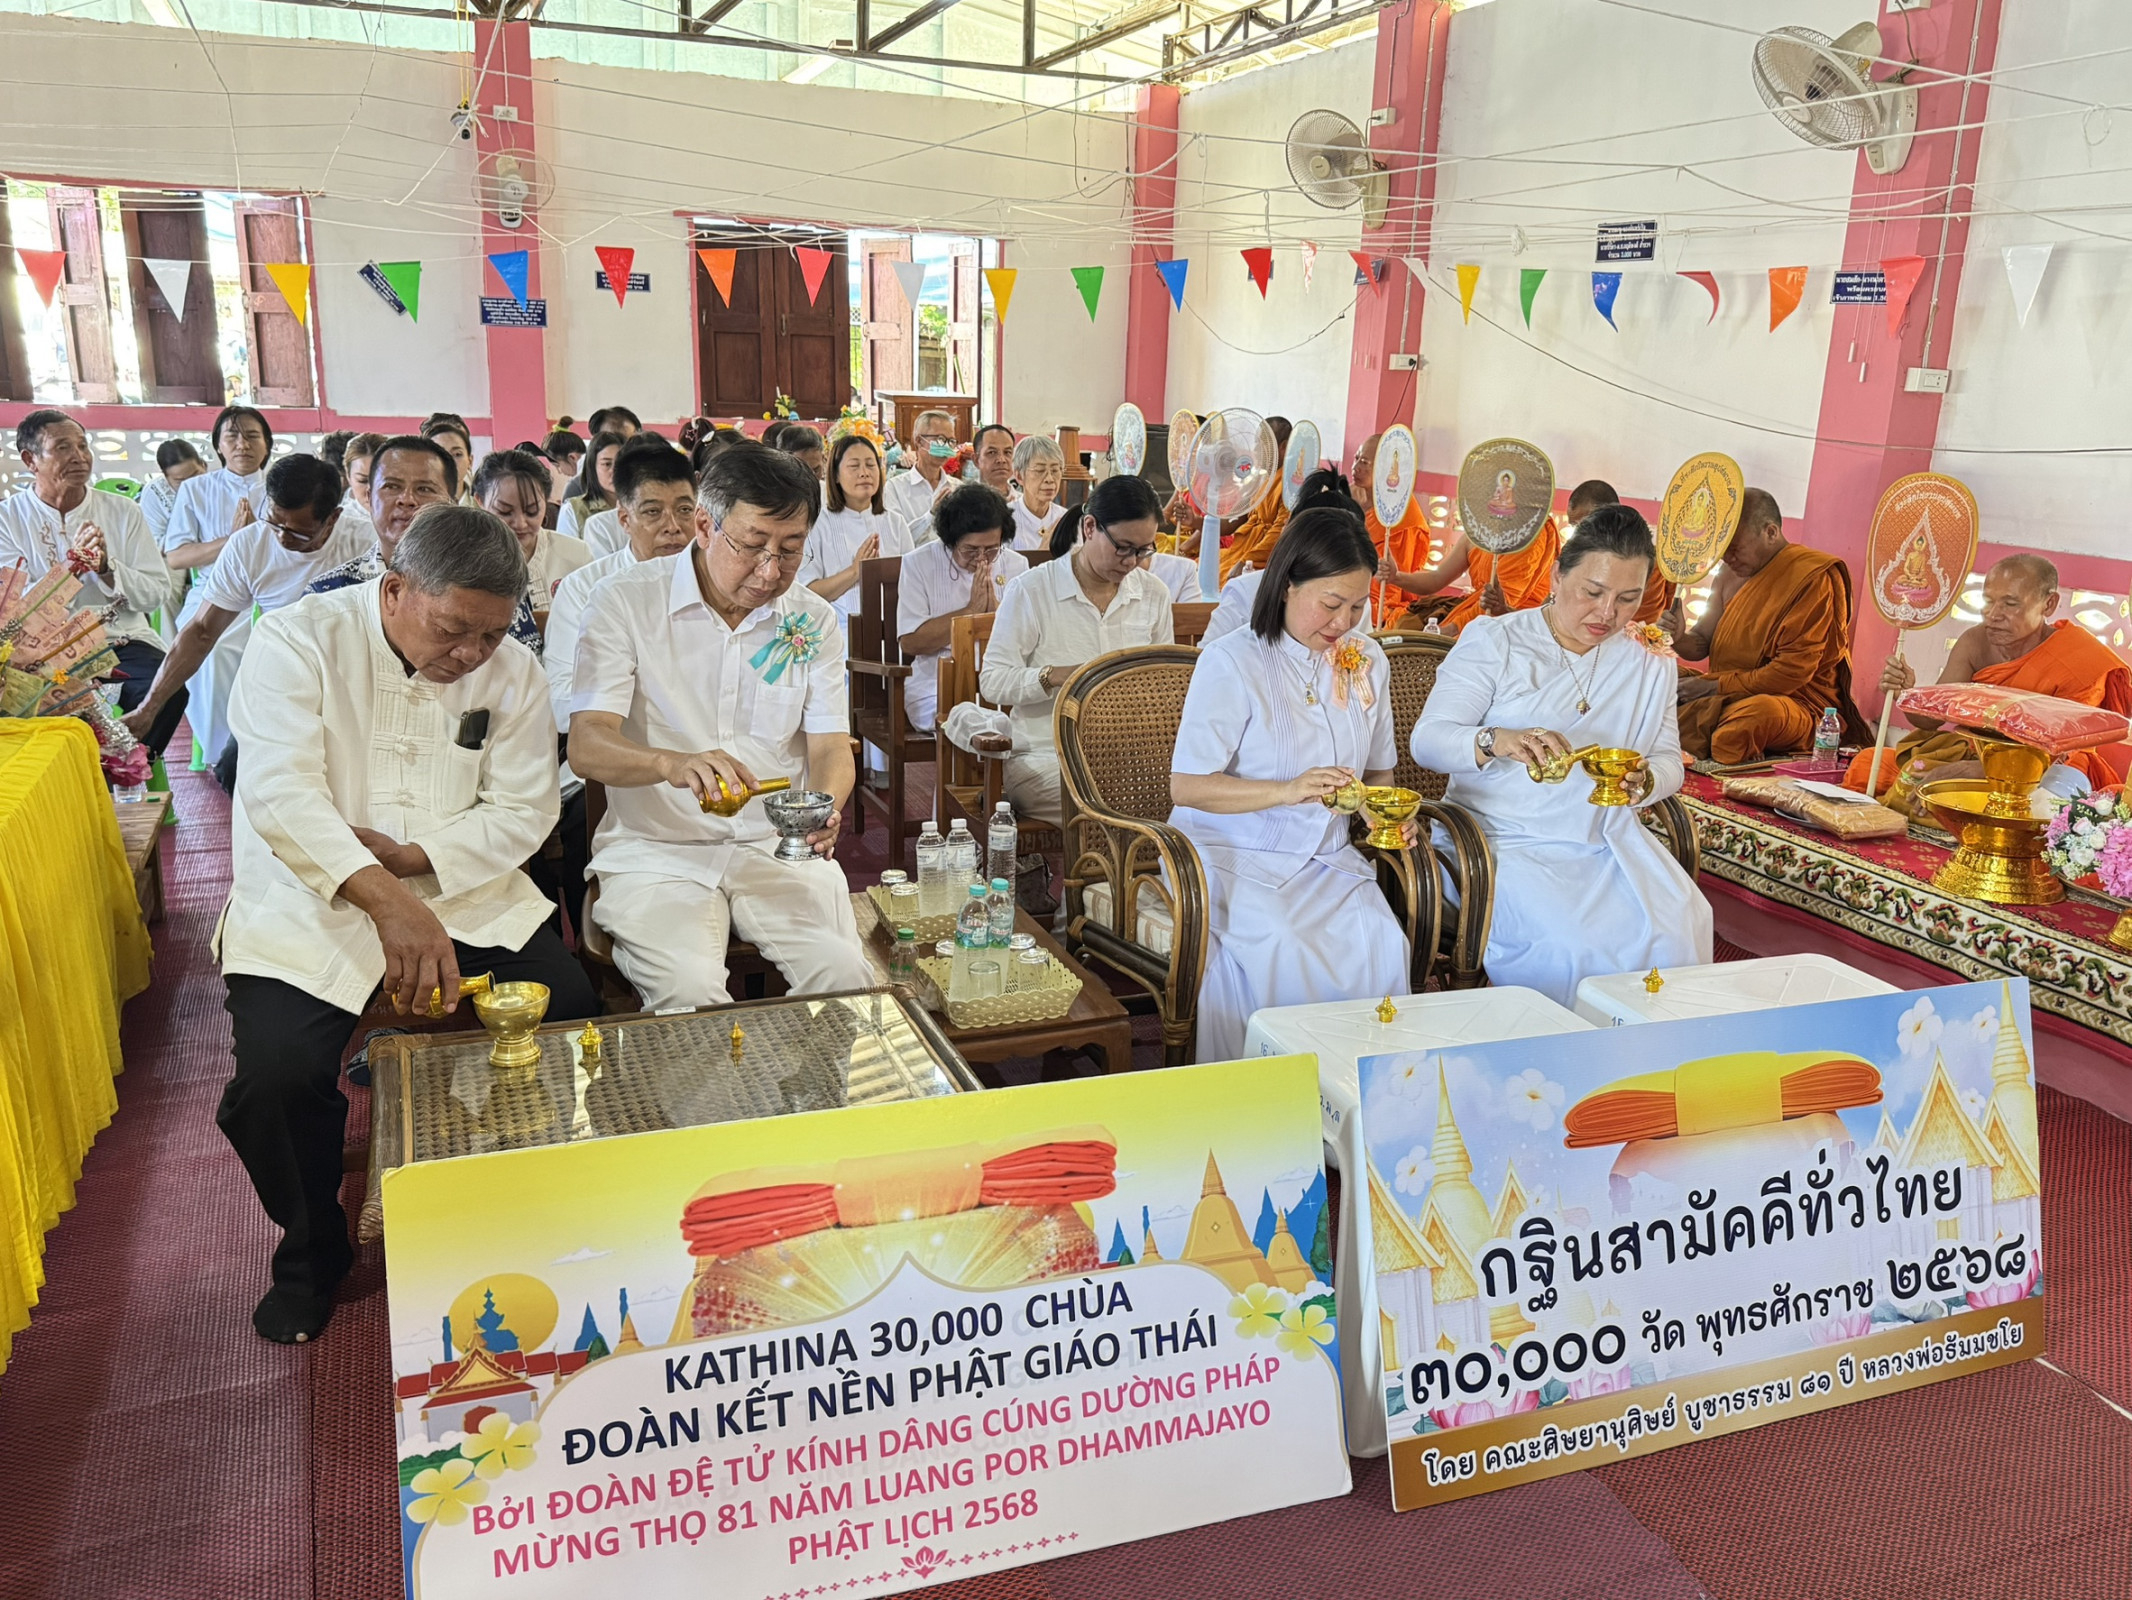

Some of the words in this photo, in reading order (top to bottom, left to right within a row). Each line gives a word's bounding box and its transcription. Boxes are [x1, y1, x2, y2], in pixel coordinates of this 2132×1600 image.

[1480, 1148, 1962, 1313] กฐินสามัคคีทั่วไทย
[562, 1405, 701, 1465] ĐOÀN
[717, 1380, 794, 1438] KẾT
[808, 1366, 895, 1422] NỀN
[910, 1348, 1011, 1403] PHẬT
[1023, 1328, 1121, 1381] GIÁO
[1130, 1309, 1218, 1358] THÁI
[665, 1327, 857, 1394] KATHINA
[870, 1302, 1002, 1357] 30,000
[1025, 1277, 1133, 1329] CHÙA
[1410, 1324, 1627, 1405] ๓๐,๐๐๐
[1641, 1308, 1686, 1354] วัด
[1696, 1278, 1874, 1357] พุทธศักราช
[1886, 1233, 2027, 1301] ๒๕๖๘
[546, 1473, 656, 1520] ĐOÀN
[667, 1455, 715, 1498] ĐỆ
[723, 1442, 775, 1482] TỬ
[787, 1432, 868, 1477] KÍNH
[879, 1416, 972, 1459] DÂNG
[982, 1397, 1072, 1435] CÚNG
[1081, 1374, 1197, 1419] DƯỜNG
[1205, 1353, 1282, 1394] PHÁP
[1425, 1453, 1475, 1482] โดย
[1485, 1396, 1676, 1471] คณะศิษยานุศิษย์
[1684, 1380, 1792, 1430] บูชาธรรม
[1800, 1371, 1831, 1396] ๘๑
[1839, 1356, 1855, 1385] ปี
[1862, 1323, 2024, 1379] หลวงพ่อธัมมชโย
[493, 1526, 620, 1578] MỪNG
[630, 1510, 707, 1549] THỌ
[717, 1502, 759, 1534] 81
[770, 1483, 854, 1525] NĂM
[866, 1459, 974, 1506] LUANG
[984, 1443, 1050, 1482] POR
[1058, 1399, 1271, 1466] DHAMMAJAYO
[788, 1518, 875, 1565] PHẬT
[884, 1505, 953, 1546] LỊCH
[964, 1488, 1039, 1530] 2568
